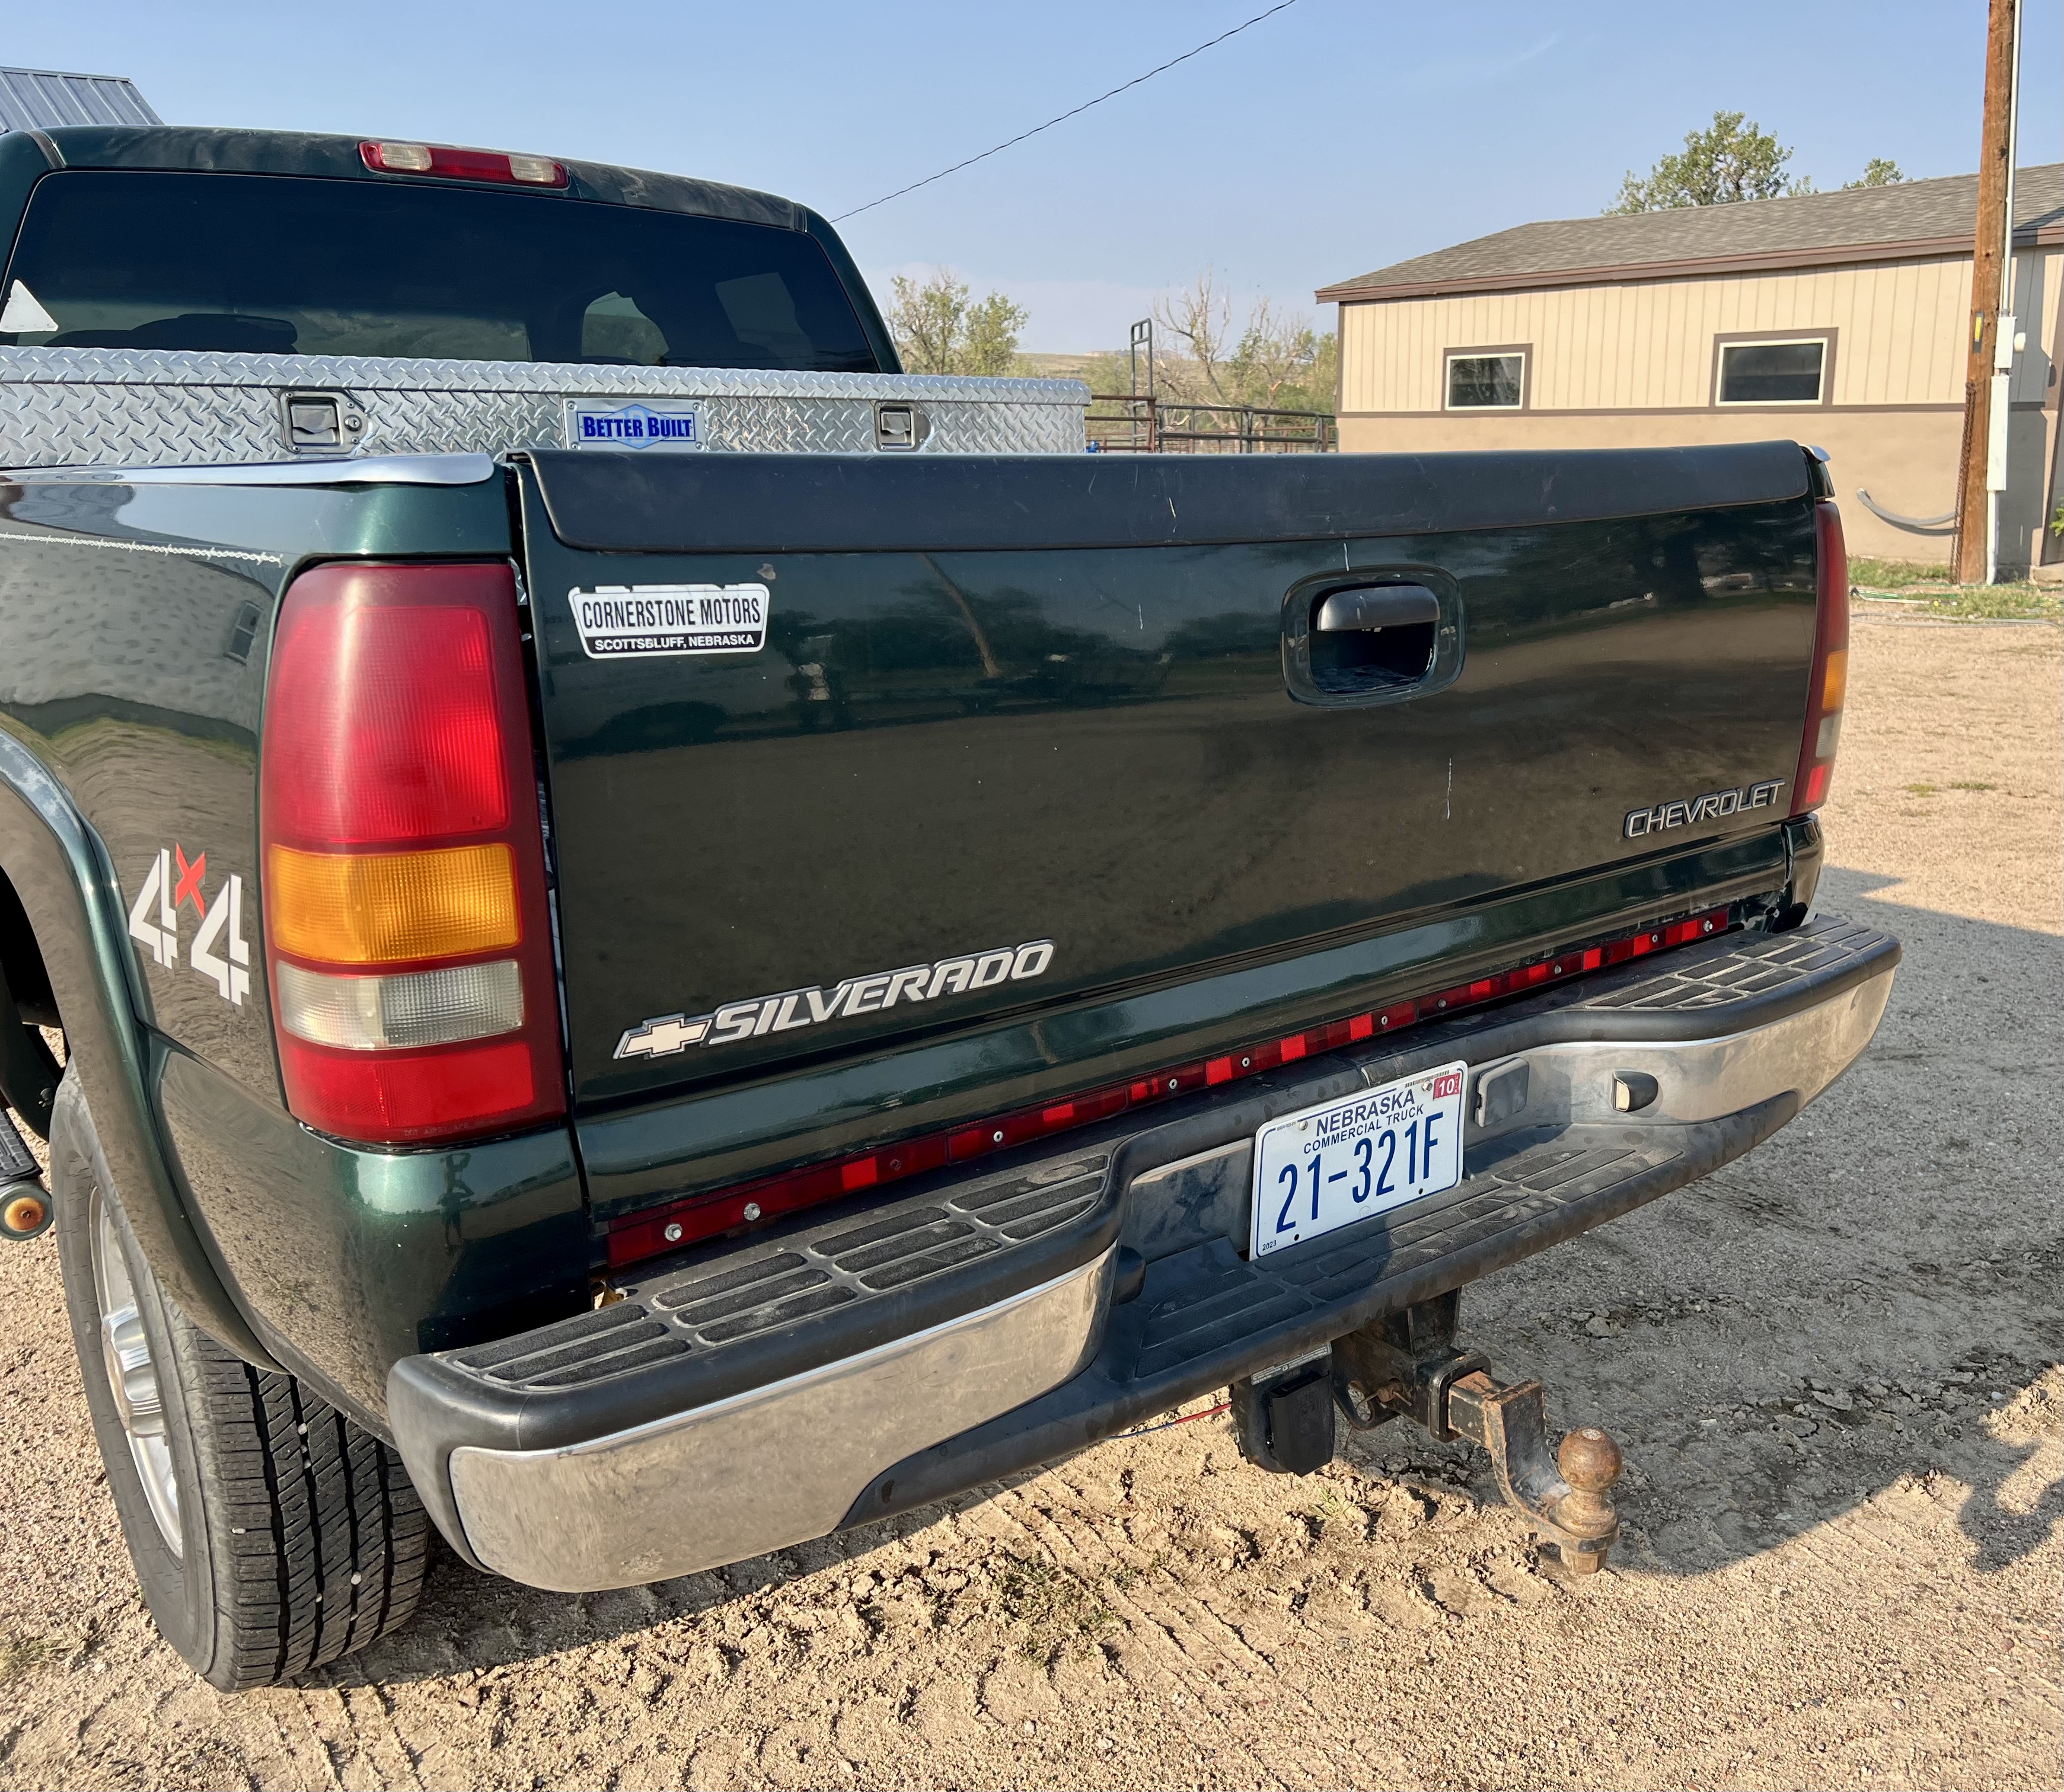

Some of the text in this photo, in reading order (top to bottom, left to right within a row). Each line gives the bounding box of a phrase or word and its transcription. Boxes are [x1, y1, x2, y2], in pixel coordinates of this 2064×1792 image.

[583, 416, 692, 437] BETTER BUILT
[582, 598, 761, 629] CORNERSTONE MOTORS
[595, 634, 755, 651] SCOTTSBLUFF, NEBRASKA
[1623, 778, 1785, 839] CHEVROLET
[708, 938, 1058, 1047] SILVERADO
[1439, 1078, 1455, 1096] 10
[1303, 1103, 1424, 1155] COMMERCIAL TRUCK
[1316, 1088, 1415, 1137] NEBRASKA
[1275, 1111, 1444, 1235] 21-321F
[1262, 1240, 1277, 1251] 2023
